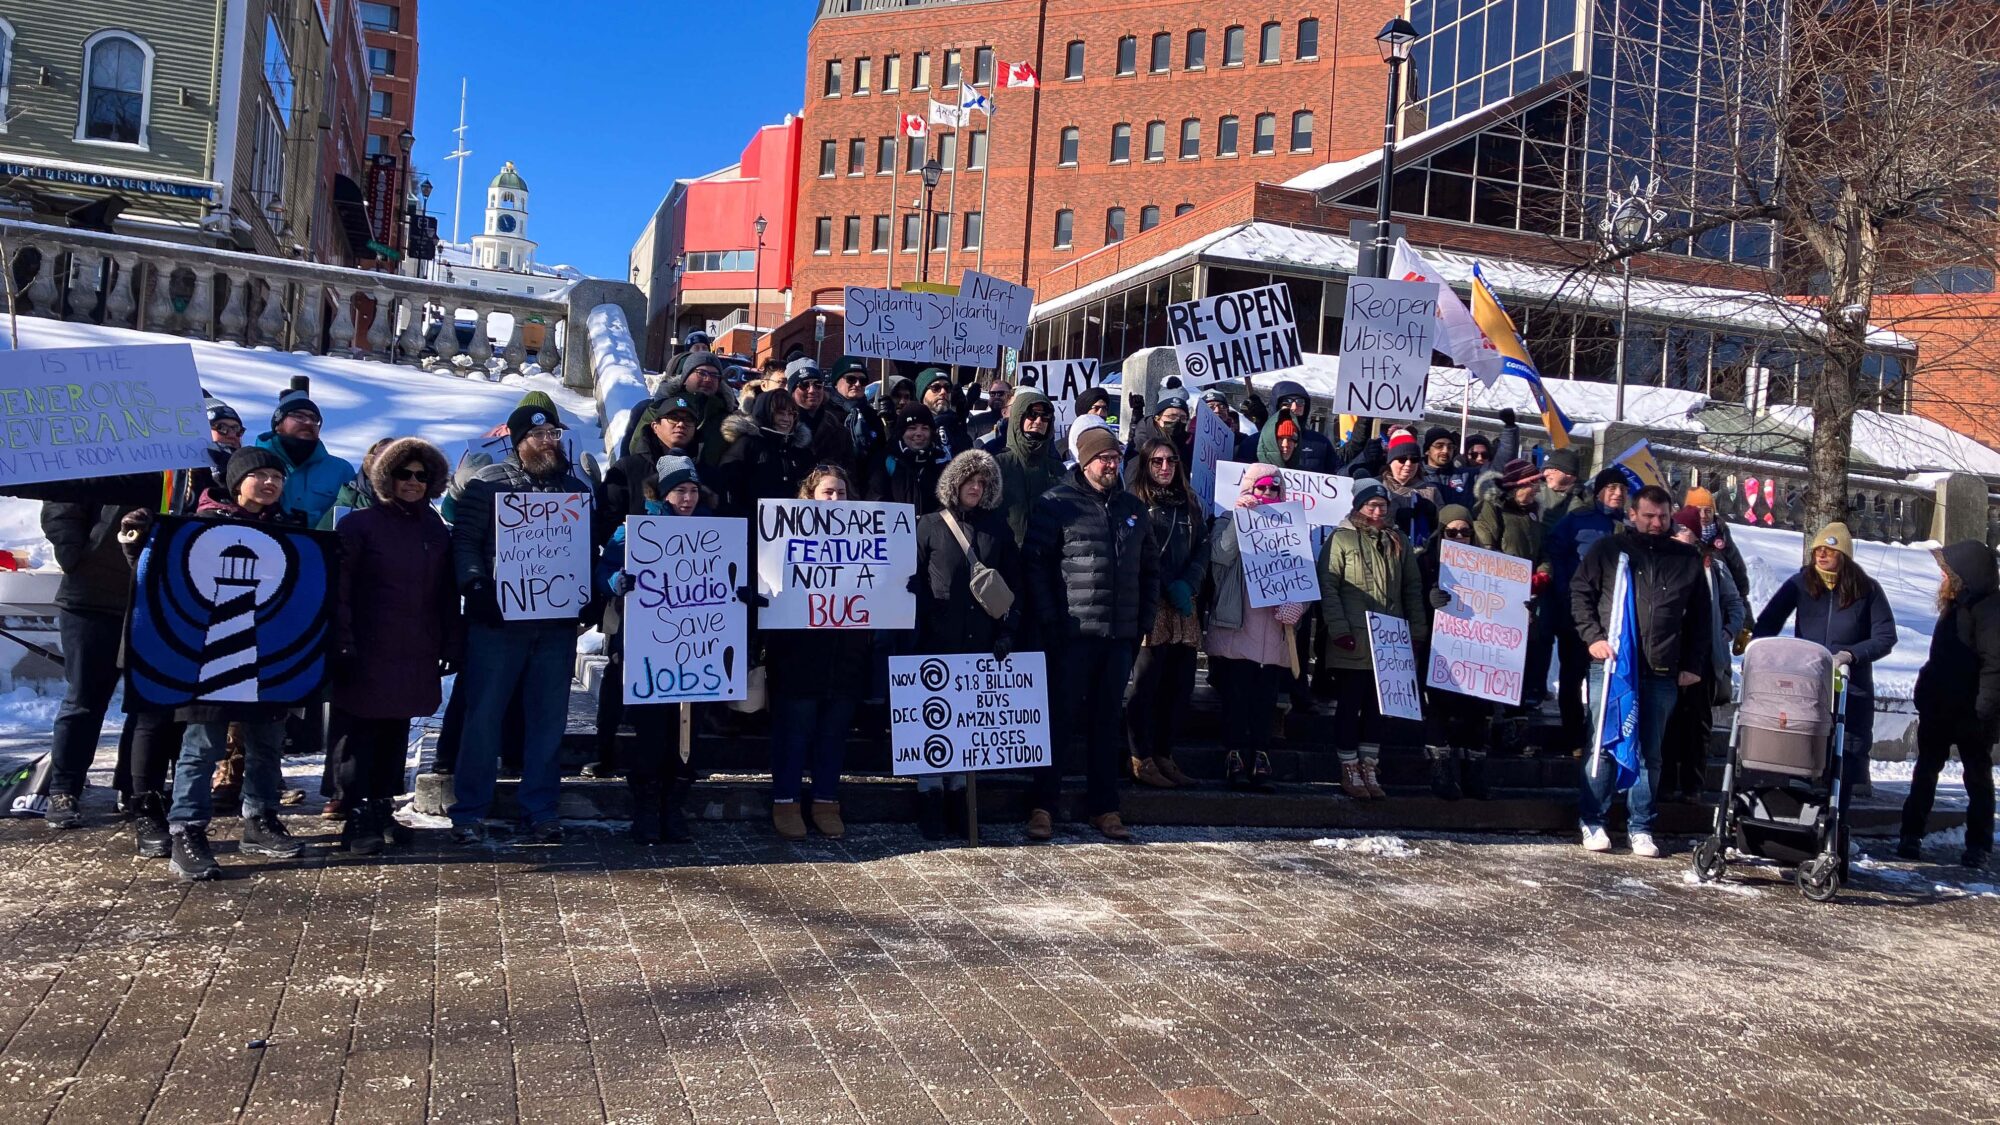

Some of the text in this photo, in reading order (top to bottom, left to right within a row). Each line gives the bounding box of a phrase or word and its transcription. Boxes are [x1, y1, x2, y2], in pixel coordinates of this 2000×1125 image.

[6, 163, 176, 195] LITTLE FISH OYSTER BAR
[845, 287, 923, 327] Solidarity
[972, 277, 1016, 309] Nerf
[1349, 283, 1436, 326] Reopen
[878, 315, 895, 332] IS
[1168, 285, 1294, 345] RE-OPEN
[953, 322, 968, 338] IS
[1344, 321, 1428, 358] Ubisoft
[848, 332, 928, 359] Multiplayer
[40, 350, 131, 373] IS THE
[1361, 355, 1402, 380] Hfx
[1021, 361, 1097, 400] PLAY
[0, 380, 156, 416] ENEROUS
[1347, 373, 1429, 418] NOW!
[0, 402, 201, 449] EVERANCE
[21, 450, 71, 472] THE
[75, 446, 124, 467] ROOM
[128, 442, 173, 462] WITH
[498, 493, 559, 528] Stop
[892, 511, 911, 534] A
[1235, 507, 1293, 534] Union
[504, 522, 572, 543] Treating
[631, 520, 722, 564] Save
[1245, 529, 1301, 558] Rights
[787, 537, 888, 563] FEATURE
[675, 555, 722, 582] our
[792, 563, 875, 589] NOT A
[1244, 554, 1305, 583] Human
[1459, 571, 1504, 595] AT THE
[501, 573, 590, 613] NPC's
[637, 562, 737, 608] Studio!
[1255, 572, 1313, 601] Rights
[808, 593, 870, 627] BUG
[1453, 584, 1505, 619] TOP
[651, 606, 725, 644] Save
[1435, 612, 1523, 650] MASSACRED
[675, 637, 719, 665] our
[976, 658, 1013, 673] GETS
[1375, 648, 1414, 673] Before
[1451, 638, 1507, 665] AT THE
[632, 645, 734, 699] Jobs!
[891, 673, 1033, 693] NOV. $1.8 BILLION
[1432, 655, 1520, 701] BOTTOM
[976, 693, 1010, 709] BUYS
[893, 707, 1041, 728] DEC. AMZN STUDIO
[971, 729, 1026, 747] CLOSES
[895, 745, 1043, 768] JAN. HFX STUDIO
